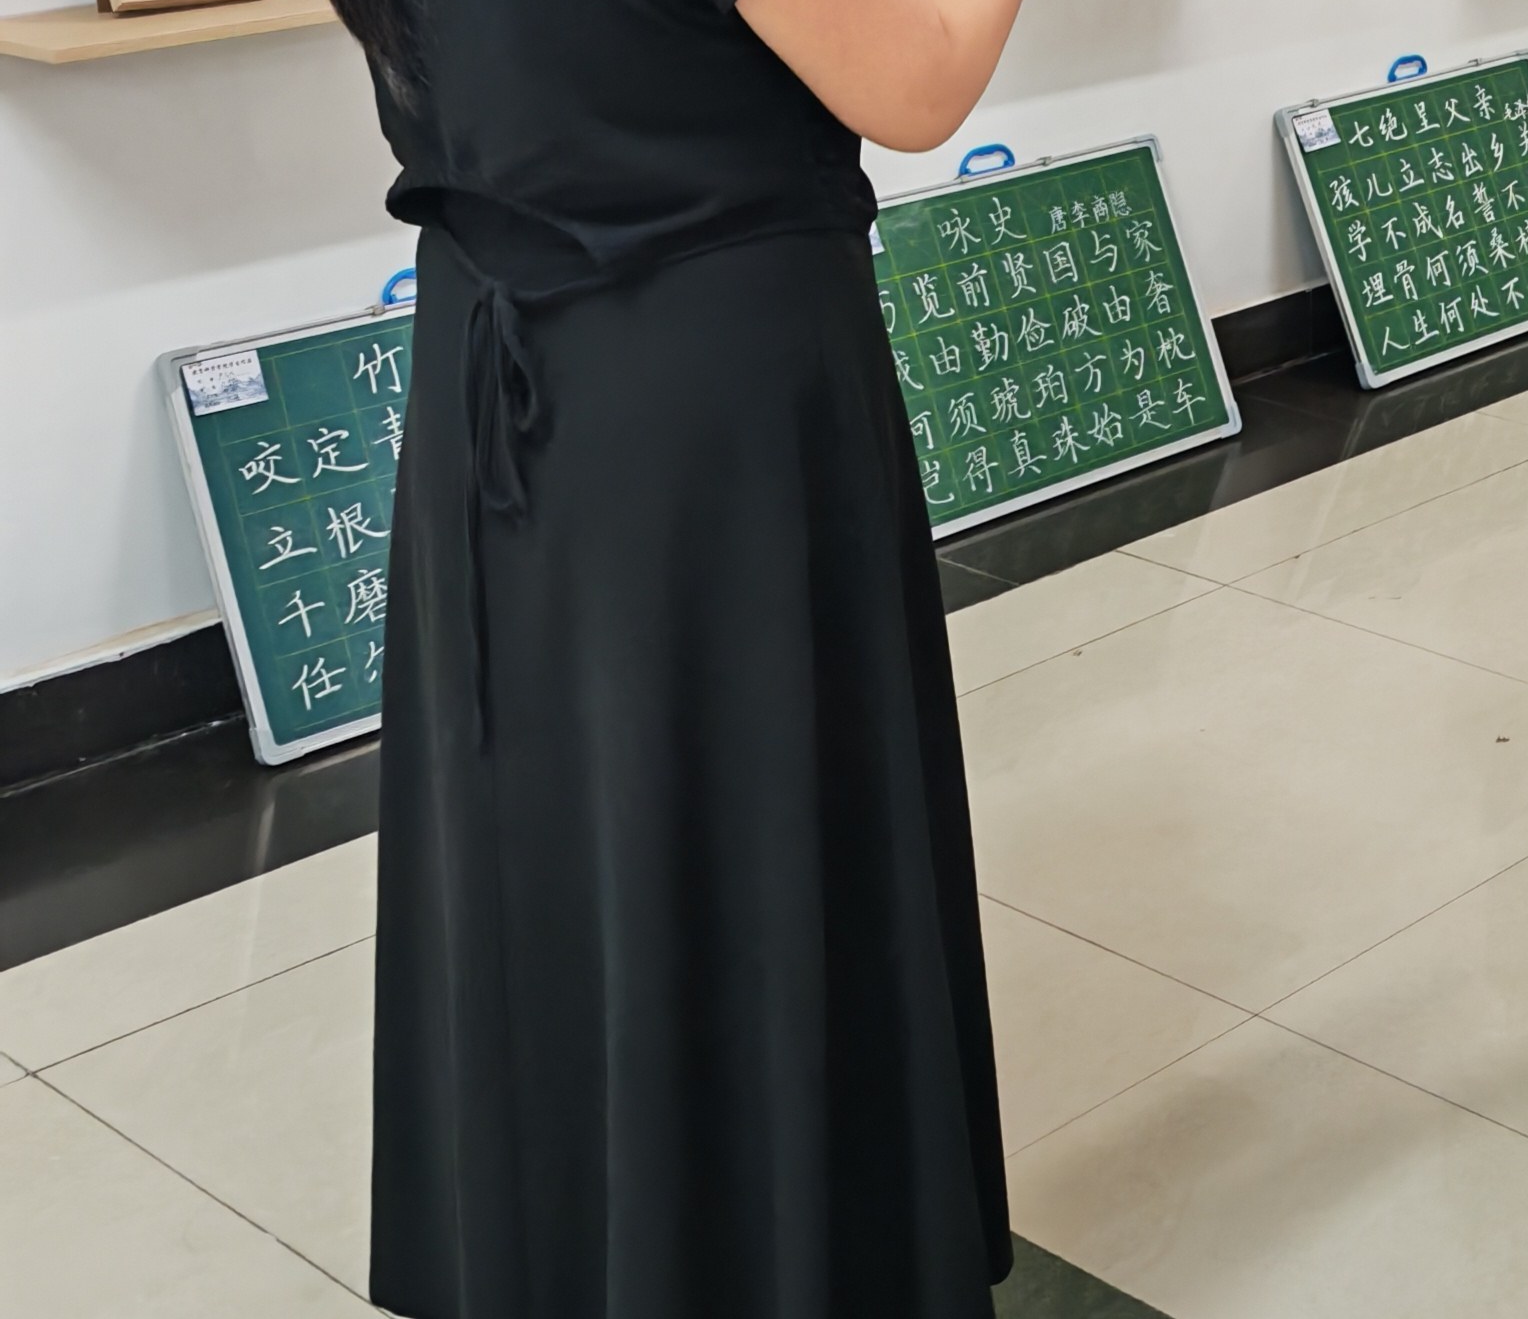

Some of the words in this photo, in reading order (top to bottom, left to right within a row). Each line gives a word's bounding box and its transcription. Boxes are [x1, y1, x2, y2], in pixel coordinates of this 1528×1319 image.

[1348, 84, 1494, 148] 七绝呈父亲
[938, 196, 1028, 255] 咏史
[1049, 190, 1132, 235] 唐李商隐
[353, 342, 405, 395] 竹
